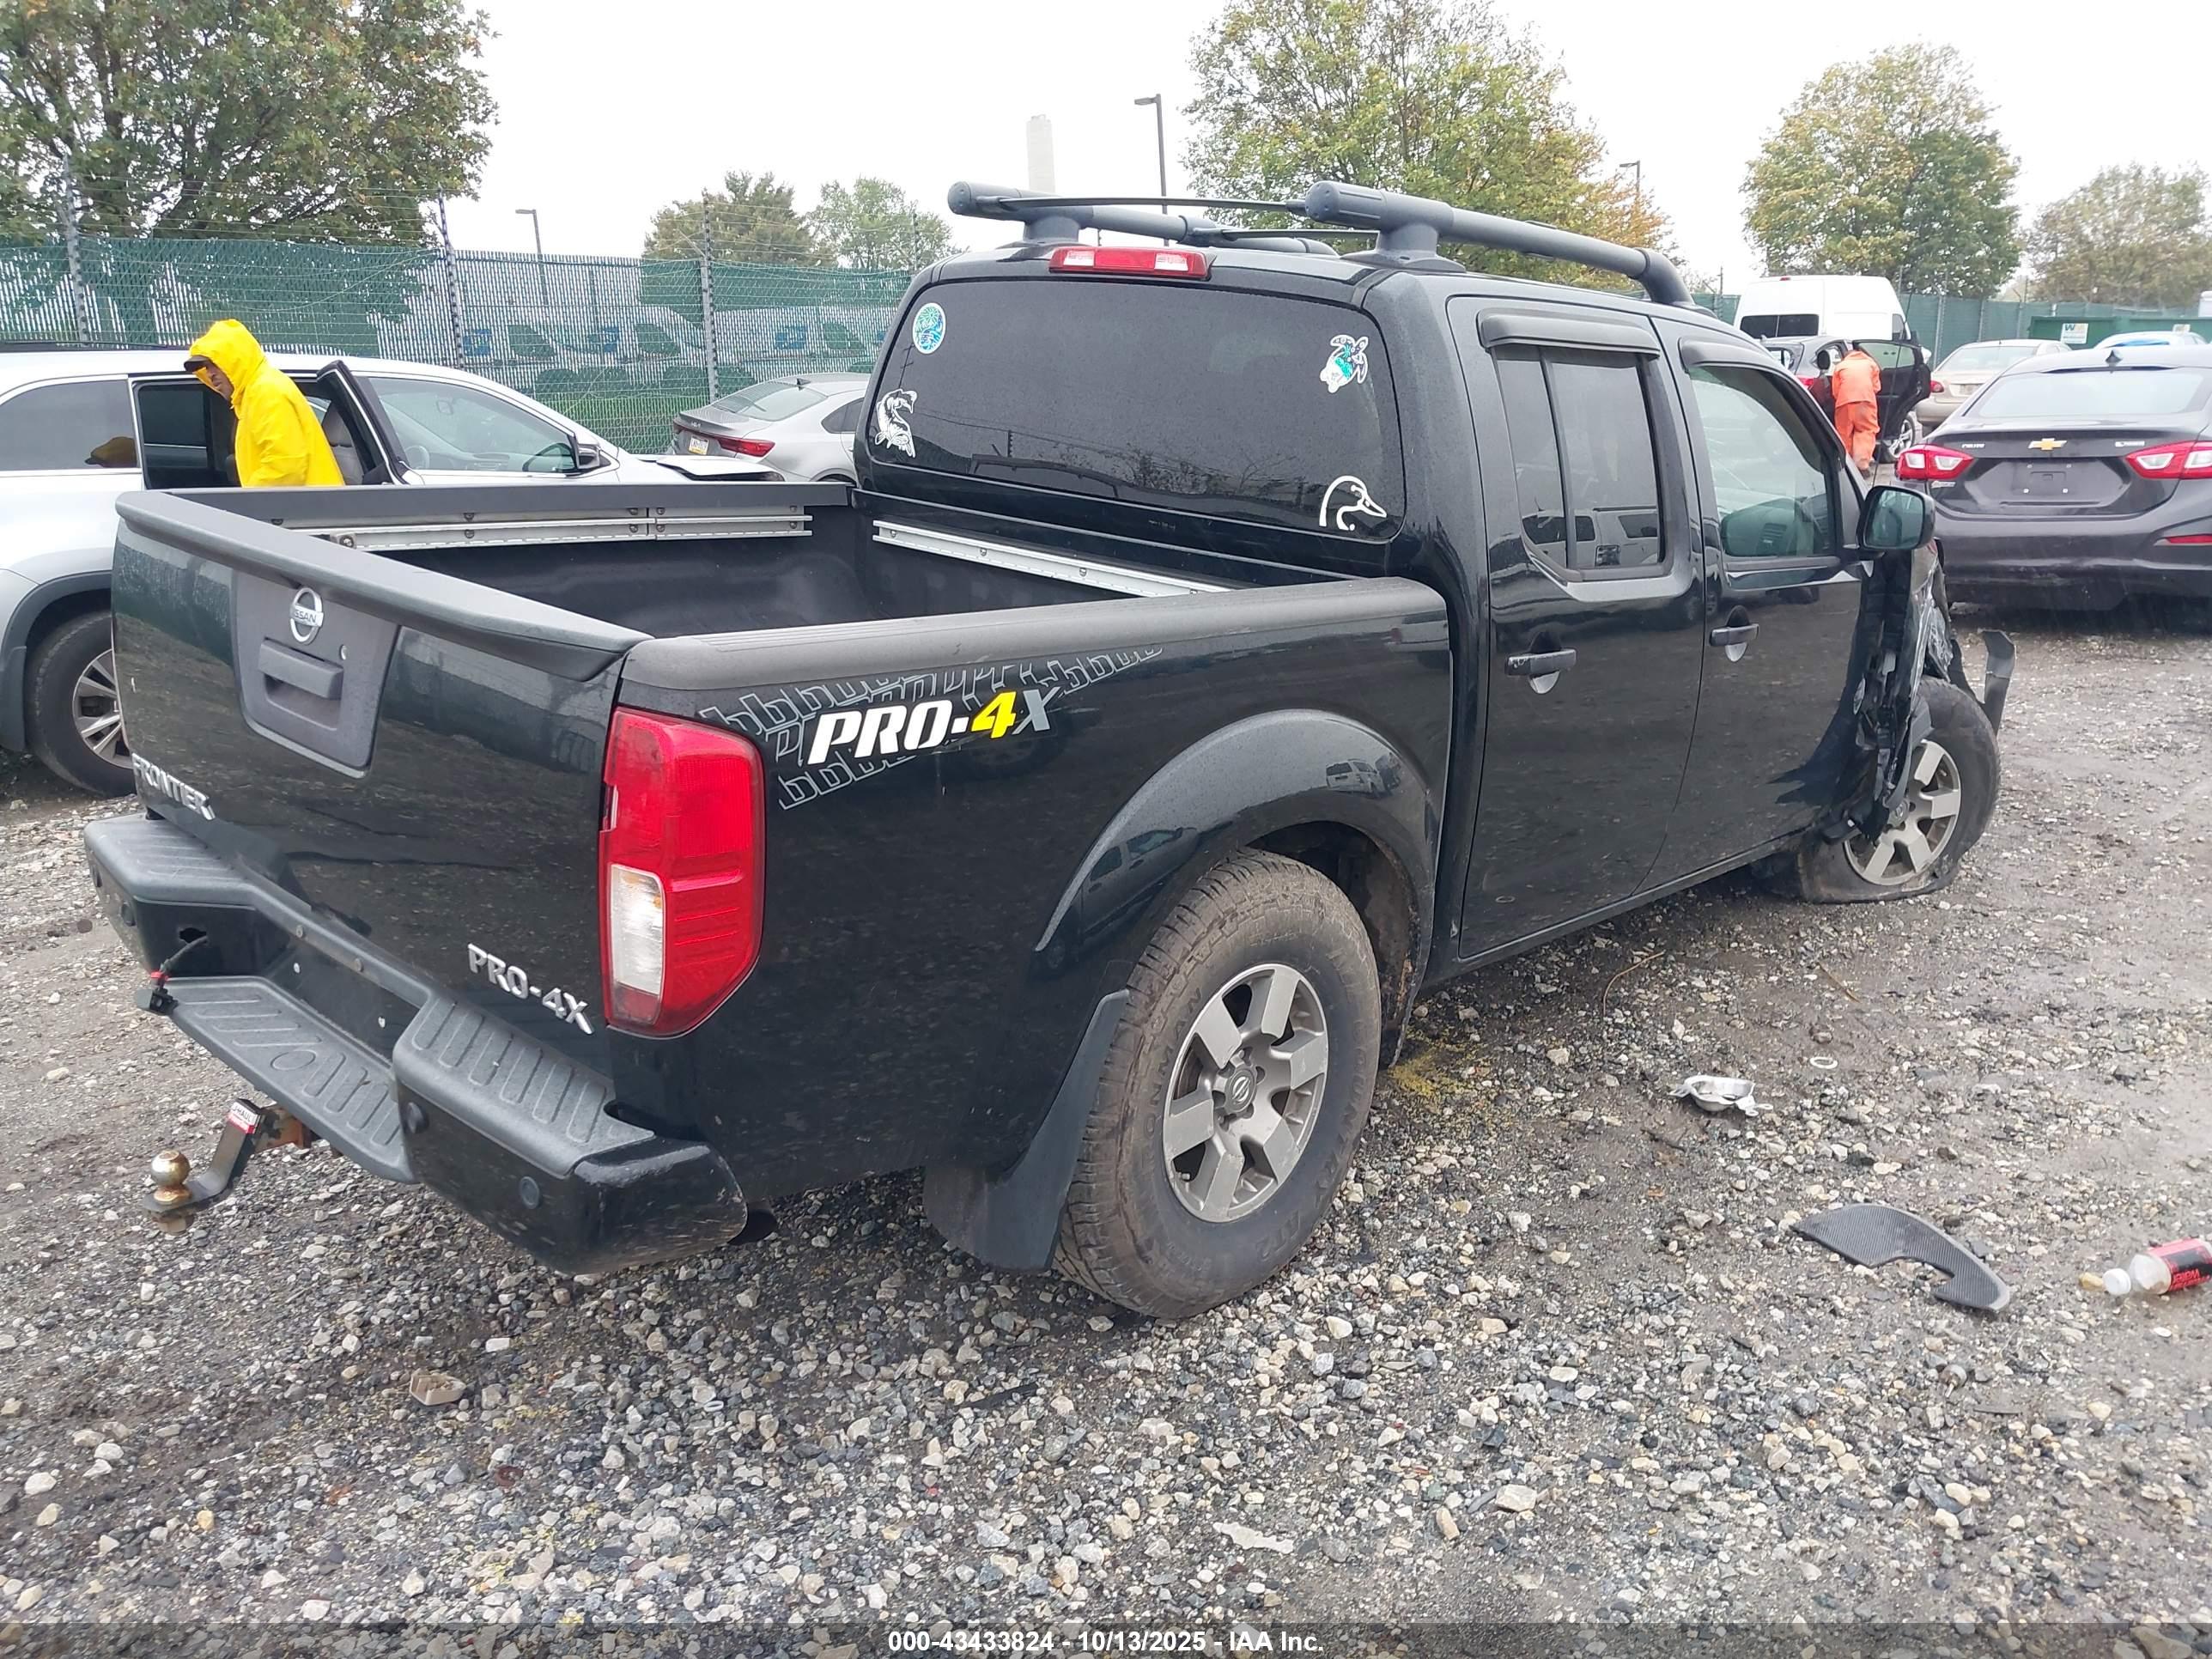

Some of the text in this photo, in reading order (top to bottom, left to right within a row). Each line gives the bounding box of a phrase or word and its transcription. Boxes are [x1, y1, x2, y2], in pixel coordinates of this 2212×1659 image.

[805, 686, 1061, 766] PRO-4X
[131, 752, 216, 821] FRONTIER
[467, 943, 595, 1035] PRO-4X
